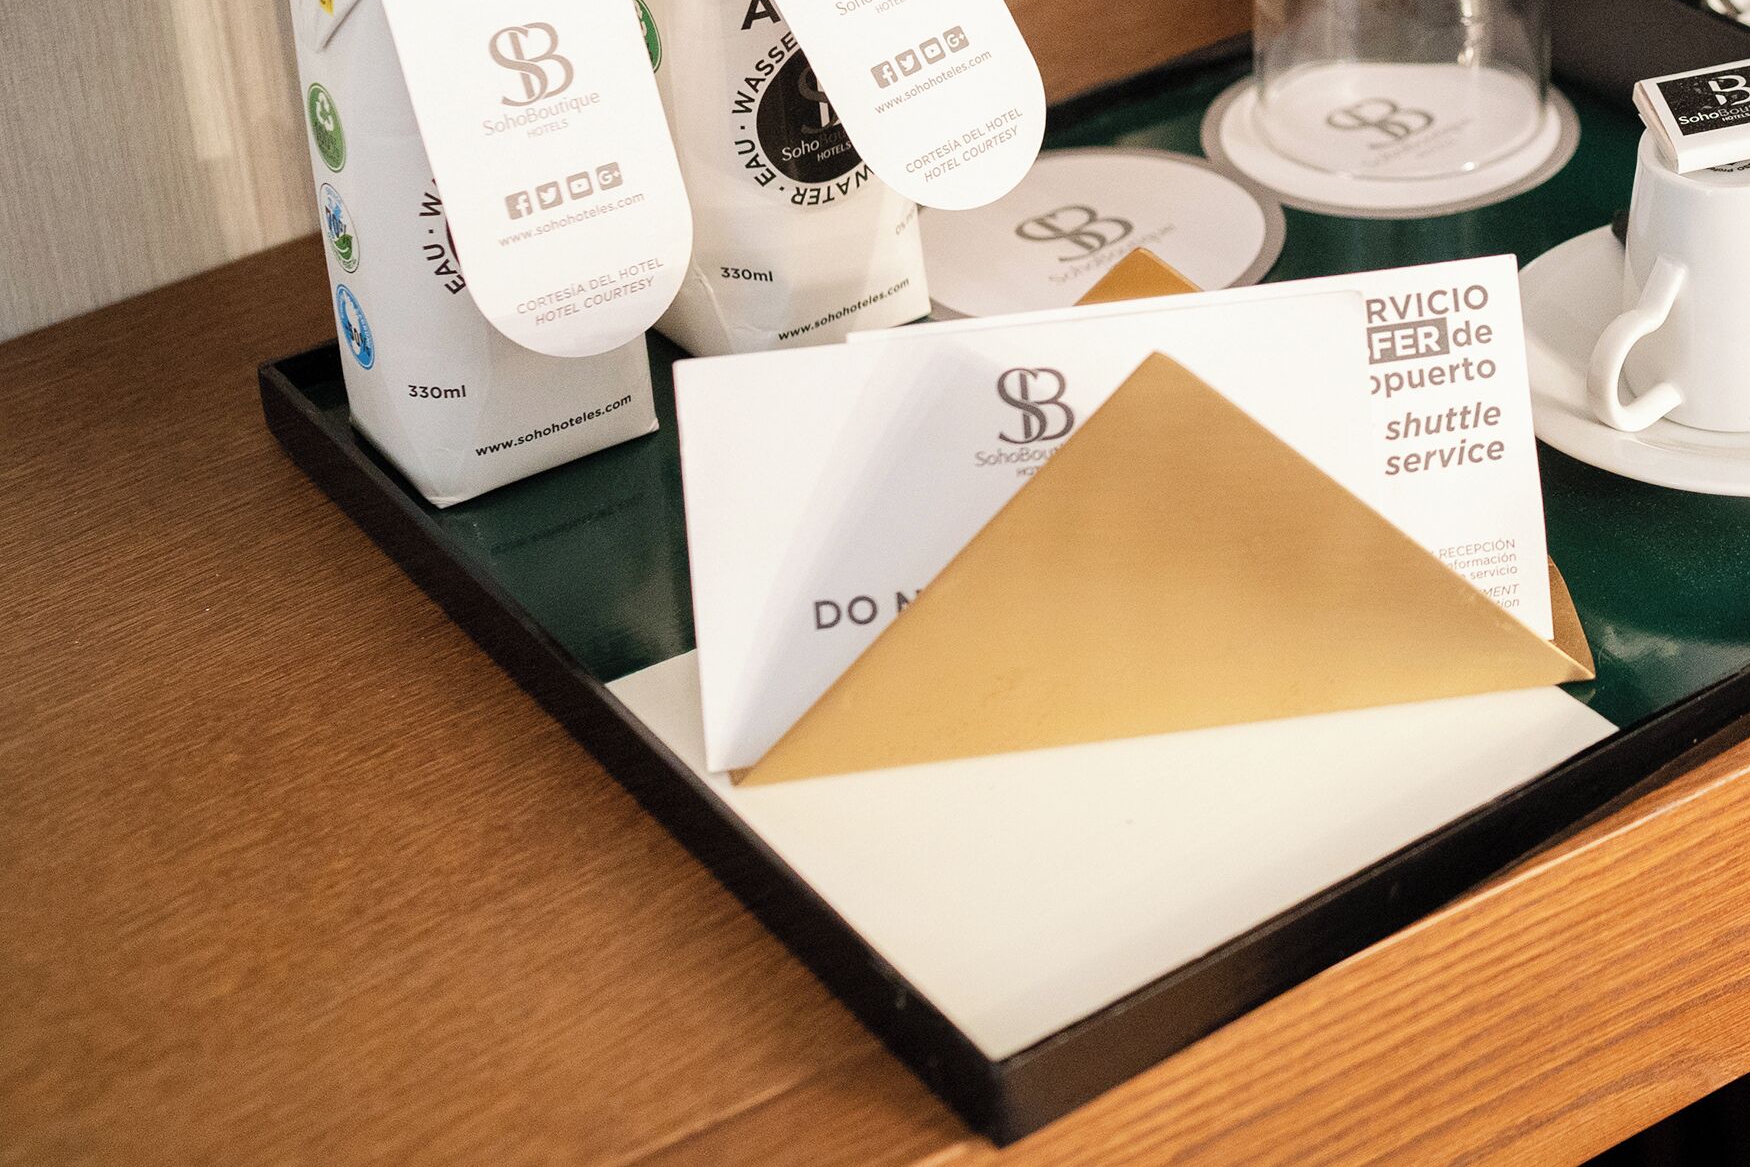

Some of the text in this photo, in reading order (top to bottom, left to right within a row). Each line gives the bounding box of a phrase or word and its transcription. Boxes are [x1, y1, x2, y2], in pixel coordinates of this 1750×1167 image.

[875, 50, 992, 114] www.sohohoteles.com
[482, 92, 600, 136] SohoBoutique
[526, 119, 569, 138] HOTELS
[1721, 113, 1750, 122] HOTELS
[905, 108, 1023, 173] CORTESÍA DEL HOTEL
[924, 125, 1018, 182] HOTEL COURTESY
[734, 139, 777, 187] EAU
[790, 164, 875, 206] WATER
[498, 193, 645, 247] www.sohohoteles.com
[422, 244, 466, 294] EAU
[516, 257, 664, 315] CORTESÍA DEL HOTEL
[720, 267, 773, 282] 330ml
[536, 276, 654, 325] HOTEL COURTESY
[778, 278, 910, 341] www.sohohoteles.com
[1366, 284, 1489, 324] RVICIO
[1368, 320, 1493, 361] FER de
[408, 385, 466, 399] 330ml
[475, 394, 632, 456] www.sohohoteles.com
[1385, 402, 1501, 440] shuttle
[1385, 438, 1505, 476] service
[1439, 538, 1516, 559] RECEPCIÓN
[1470, 564, 1518, 580] servicio
[814, 595, 878, 630] DO
